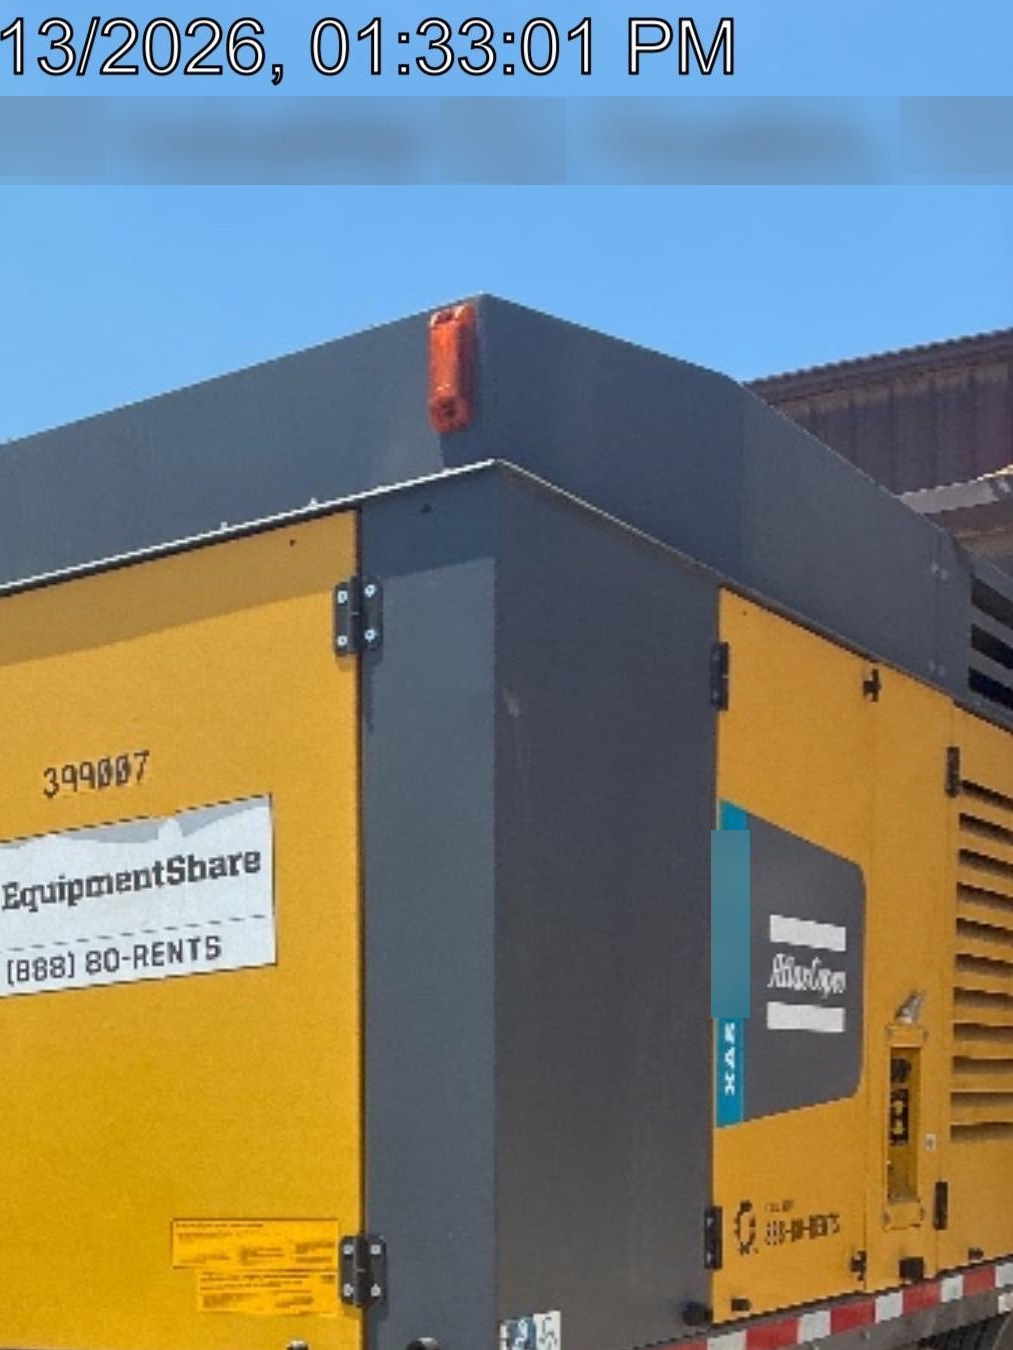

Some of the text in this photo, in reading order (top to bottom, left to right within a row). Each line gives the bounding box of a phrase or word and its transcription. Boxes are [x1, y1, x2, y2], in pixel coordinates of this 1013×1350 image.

[44, 750, 150, 798] 399007
[1, 851, 261, 912] EquipmentShare
[85, 935, 222, 974] 80-RENTS
